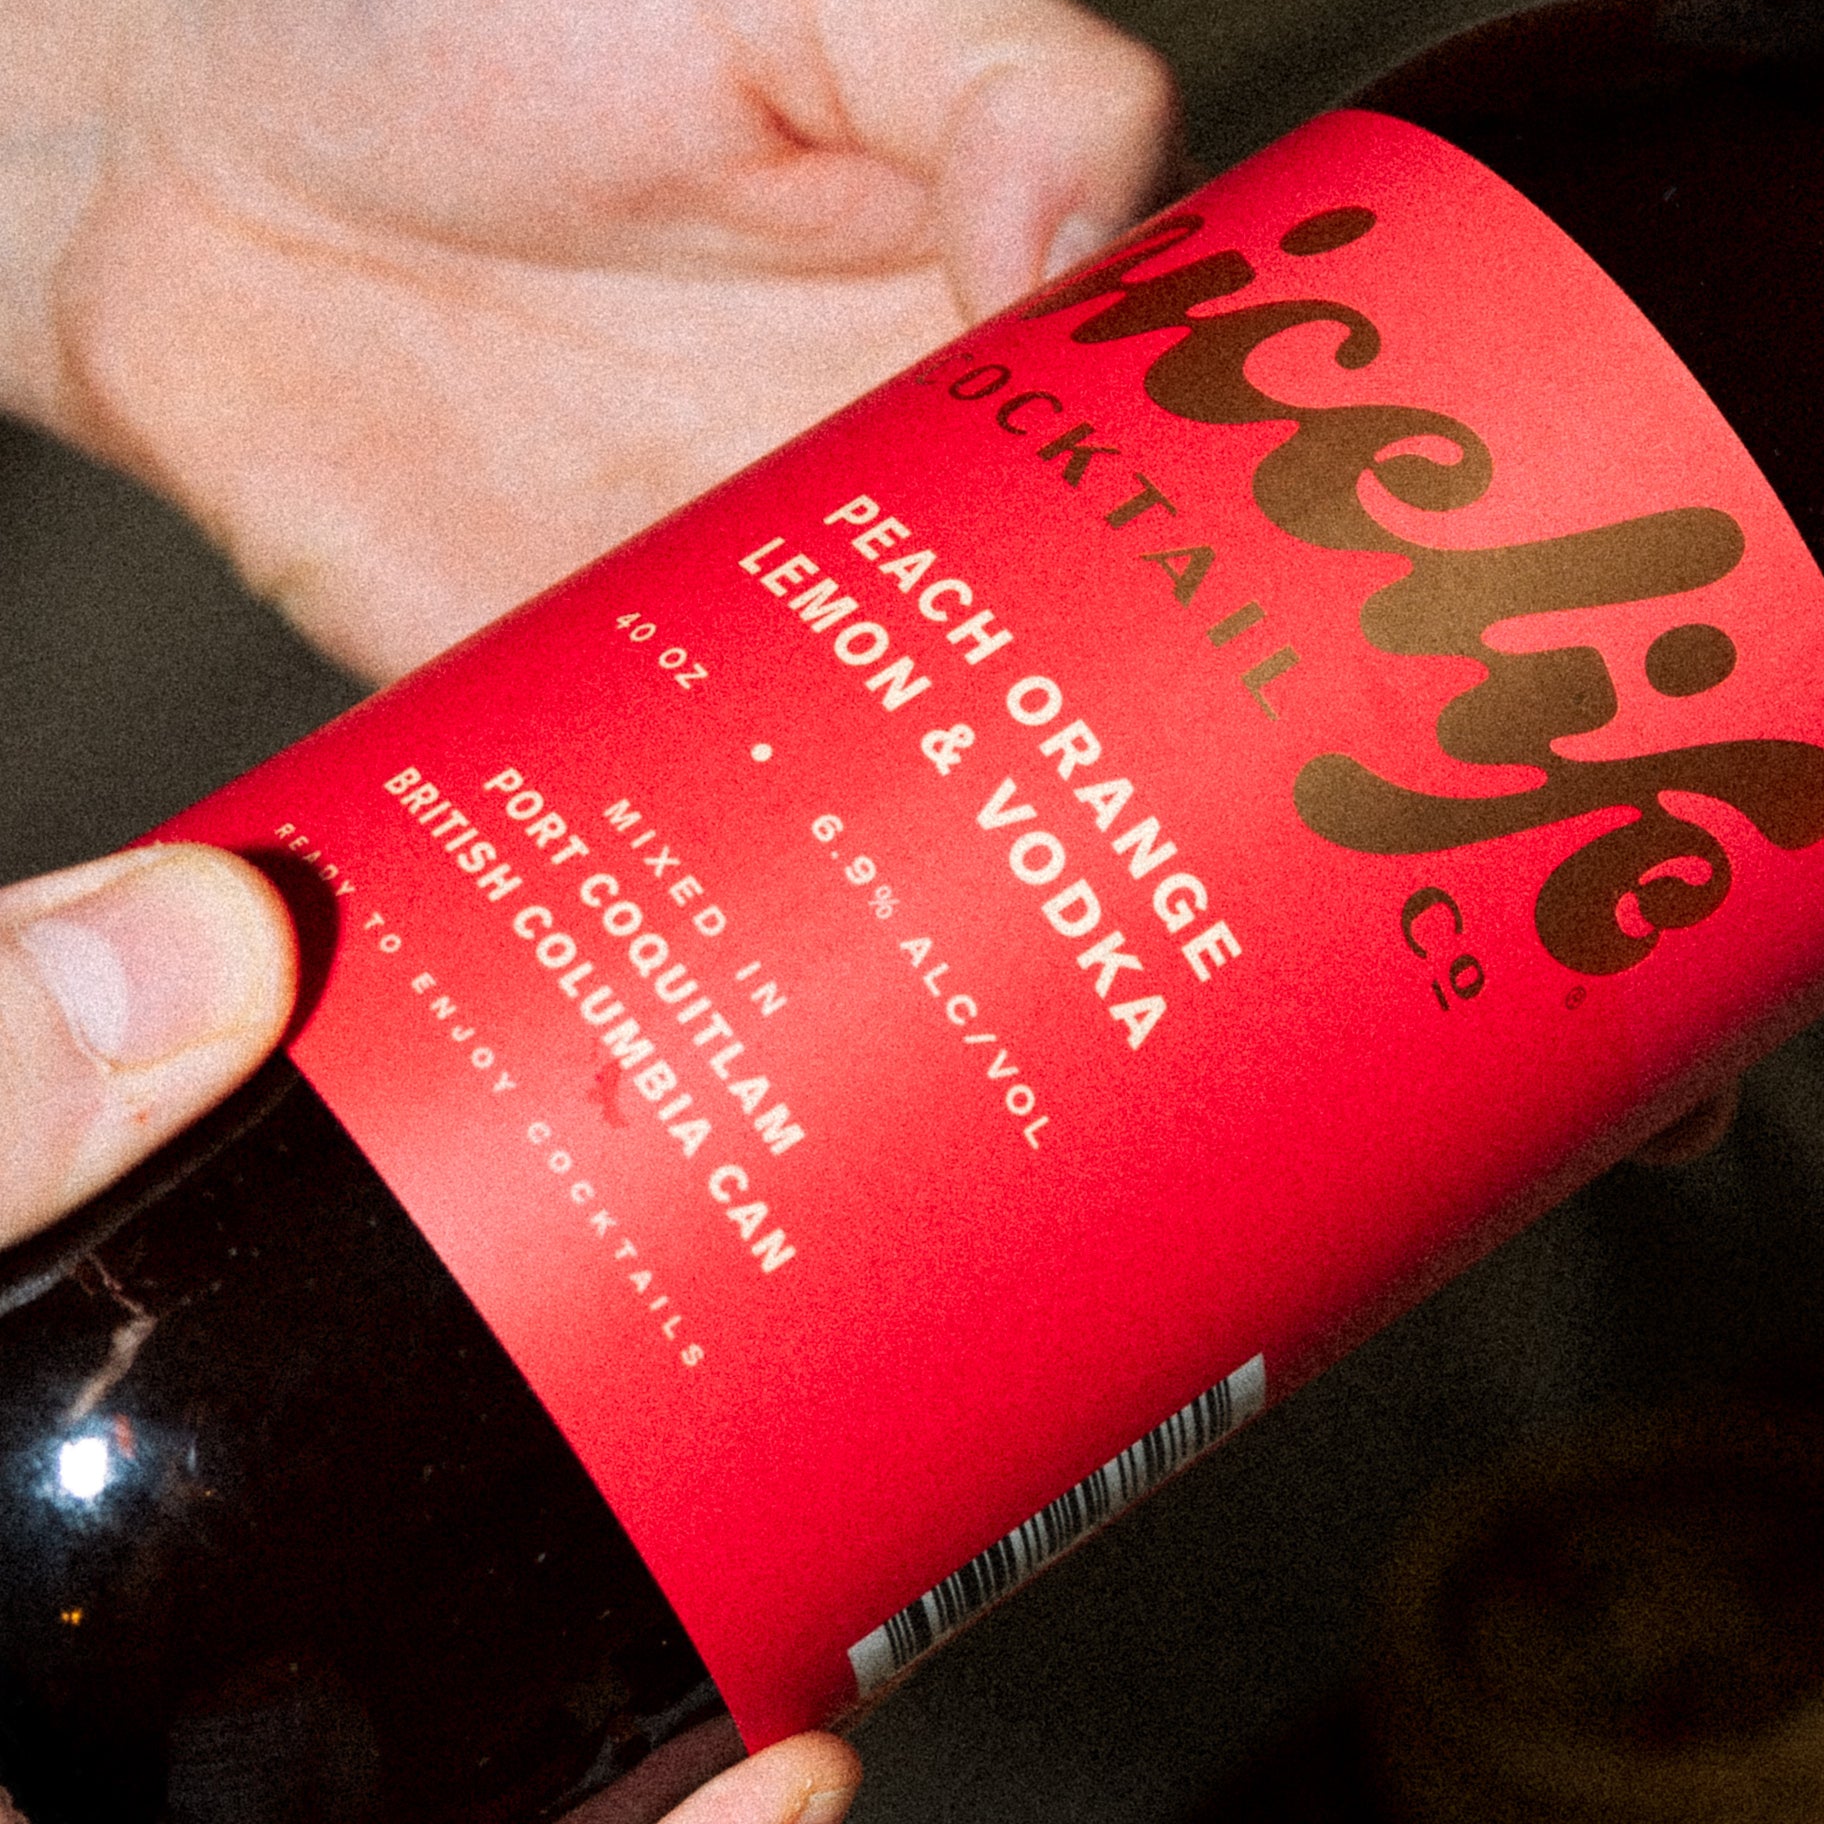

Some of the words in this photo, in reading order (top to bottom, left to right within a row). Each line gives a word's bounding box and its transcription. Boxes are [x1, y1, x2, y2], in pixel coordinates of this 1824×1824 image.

[823, 494, 1013, 665] PEACH
[1006, 675, 1242, 982] ORANGE
[915, 352, 1301, 722] COCKTAIL
[384, 766, 522, 902] BRITISH
[512, 904, 712, 1158] COLUMBIA
[708, 1164, 797, 1274] CAN
[483, 767, 589, 865] PORT
[579, 872, 805, 1156] COQUITLAM
[604, 798, 727, 938] MIXED
[735, 961, 788, 1017] IN
[615, 611, 657, 642] 40
[658, 647, 709, 689] OZ
[811, 813, 900, 920] 6.9%
[900, 936, 1049, 1149] ALC/VOL
[738, 537, 931, 711] LEMON
[920, 723, 975, 775] &
[976, 777, 1167, 1051] VODKA
[274, 822, 356, 897] READY
[363, 910, 402, 954] TO
[410, 971, 517, 1094] ENJOY
[526, 1120, 704, 1367] COCKTAILS
